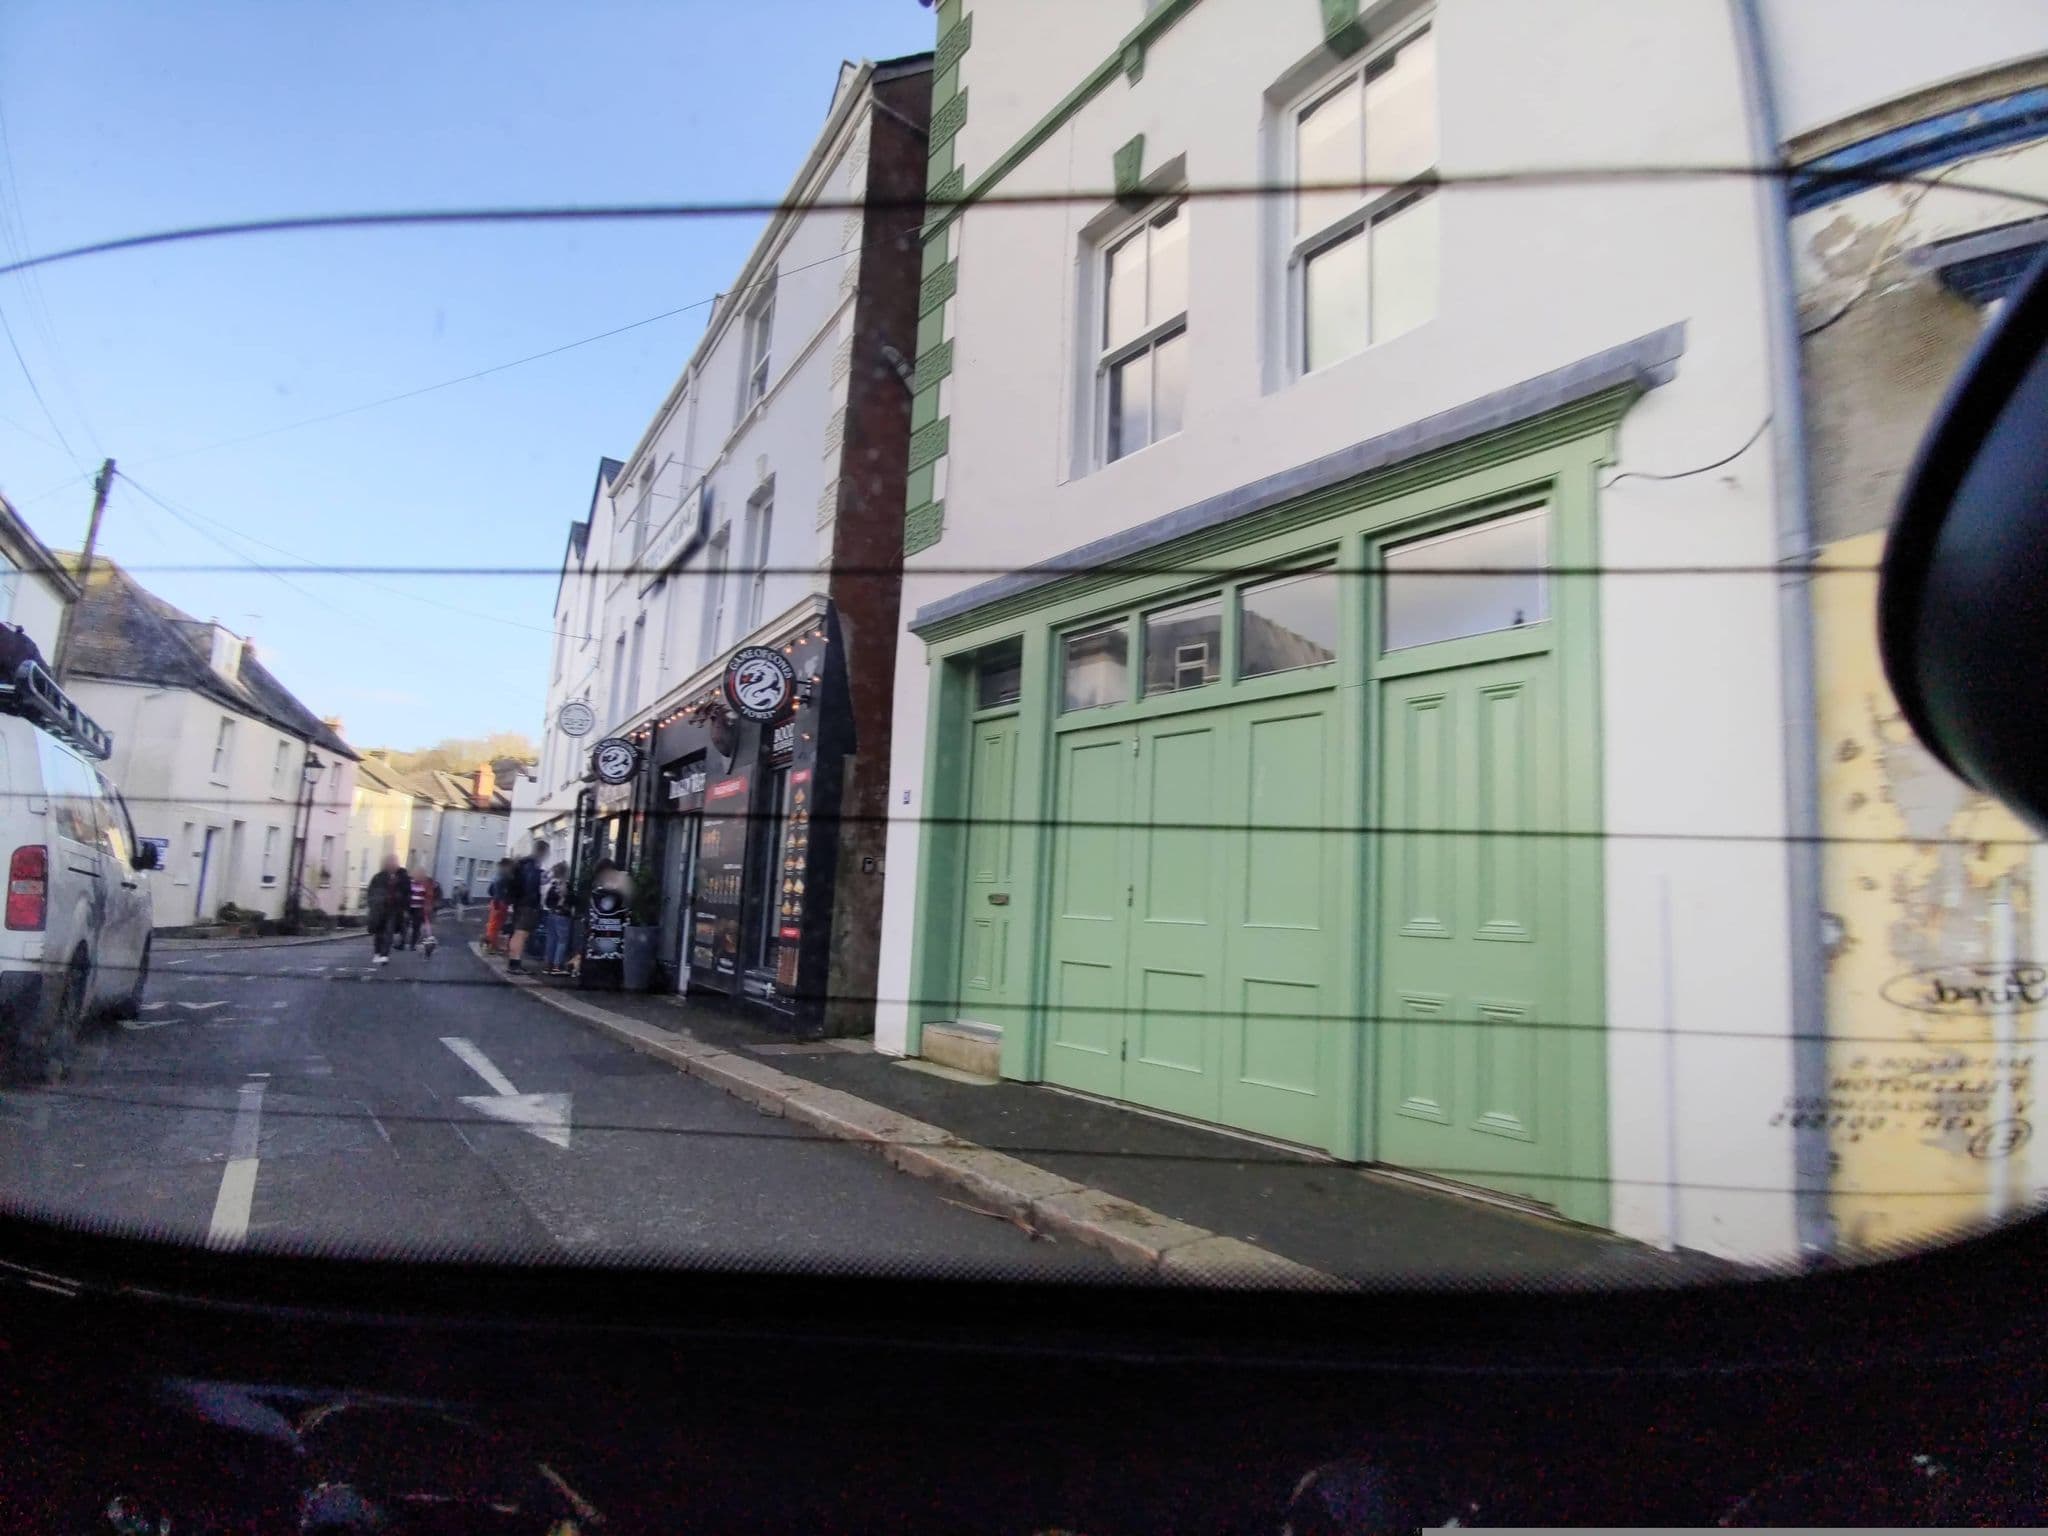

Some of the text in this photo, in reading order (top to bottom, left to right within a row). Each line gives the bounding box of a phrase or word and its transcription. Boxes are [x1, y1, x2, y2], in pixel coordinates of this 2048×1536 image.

[729, 649, 793, 679] GAME OF CONES
